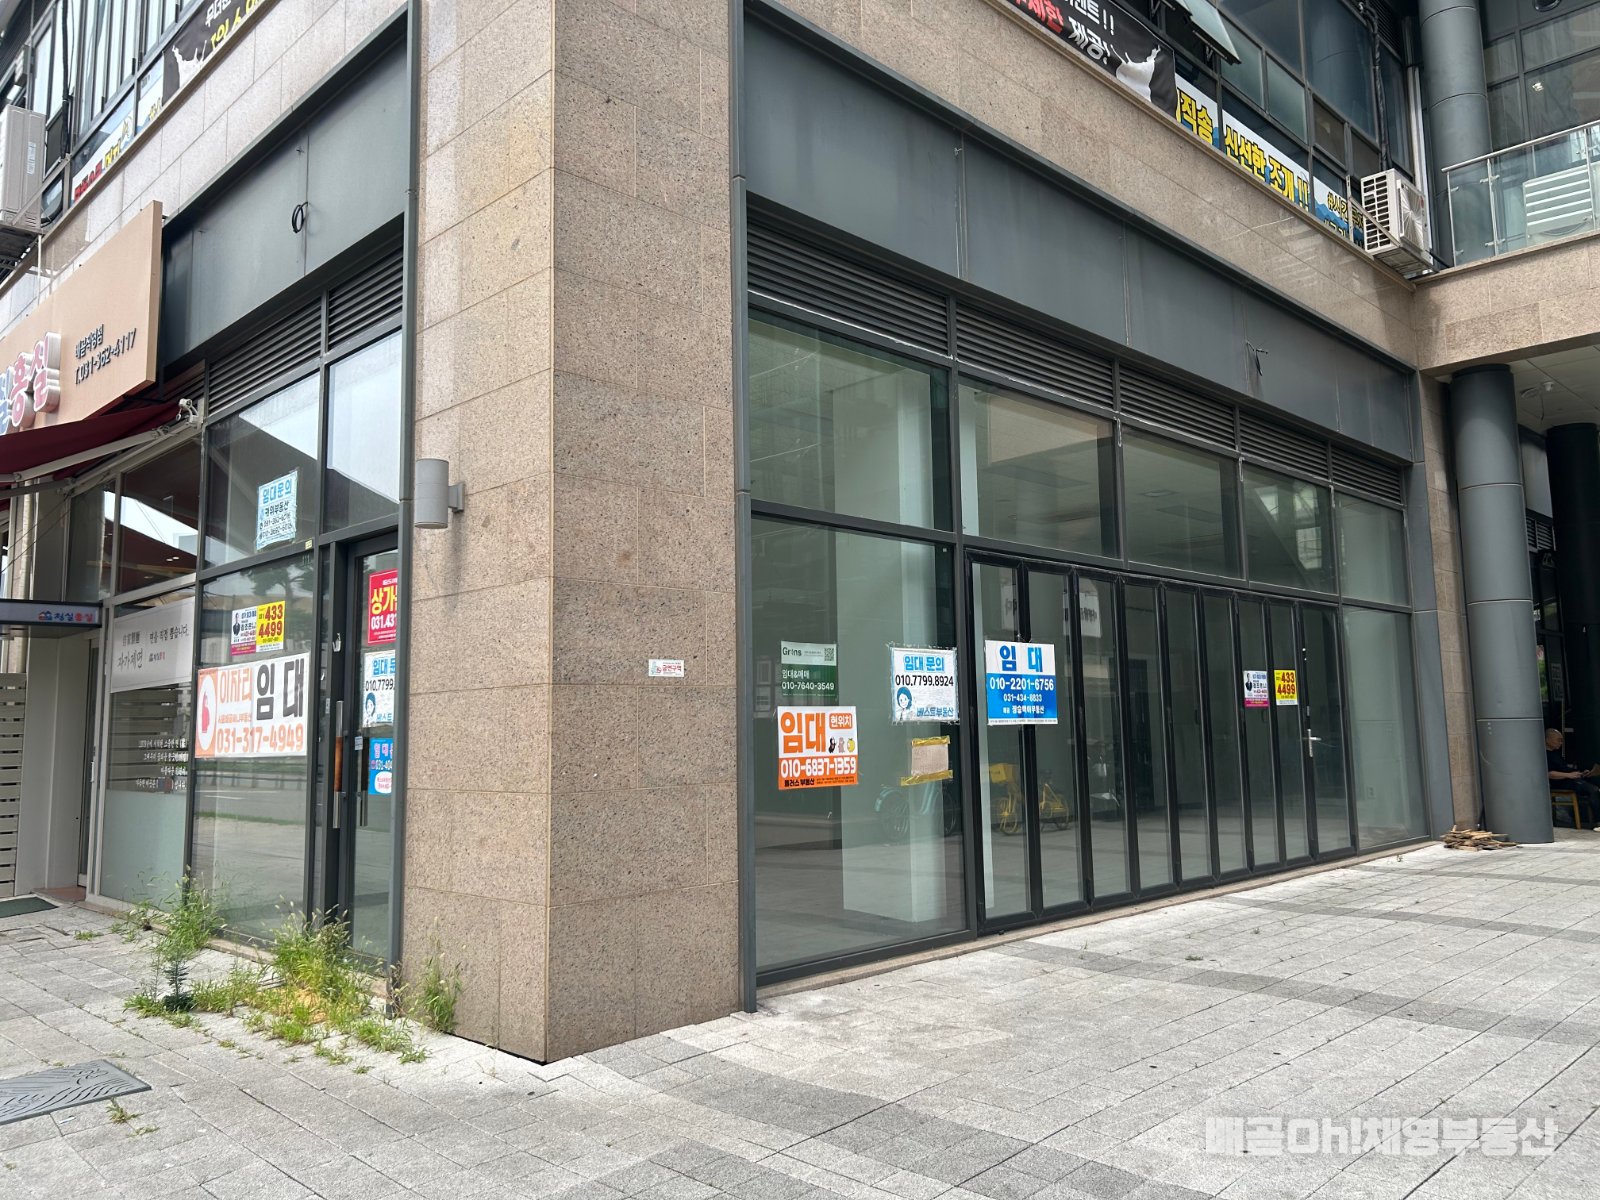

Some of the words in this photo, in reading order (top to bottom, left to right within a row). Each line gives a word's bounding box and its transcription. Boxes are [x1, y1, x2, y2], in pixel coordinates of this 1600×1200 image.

[1067, 16, 1111, 65] 제공!
[1176, 87, 1213, 146] 직송
[1225, 124, 1266, 183] 신선한
[1268, 155, 1295, 202] 조개
[265, 603, 283, 621] 433
[258, 620, 283, 638] 4499
[373, 658, 388, 675] 임대
[904, 655, 924, 671] 임대
[926, 656, 945, 672] 문의
[781, 681, 835, 691] 010-7640-3549
[895, 674, 954, 687] 010.7799.8924
[989, 676, 1055, 691] 010-2201-6756
[1281, 671, 1295, 684] 433
[1277, 683, 1296, 695] 4499
[216, 723, 304, 754] 031-317-4949
[780, 711, 826, 754] 임대
[830, 714, 852, 728] 현위치
[780, 756, 857, 779] 010-6837-1359
